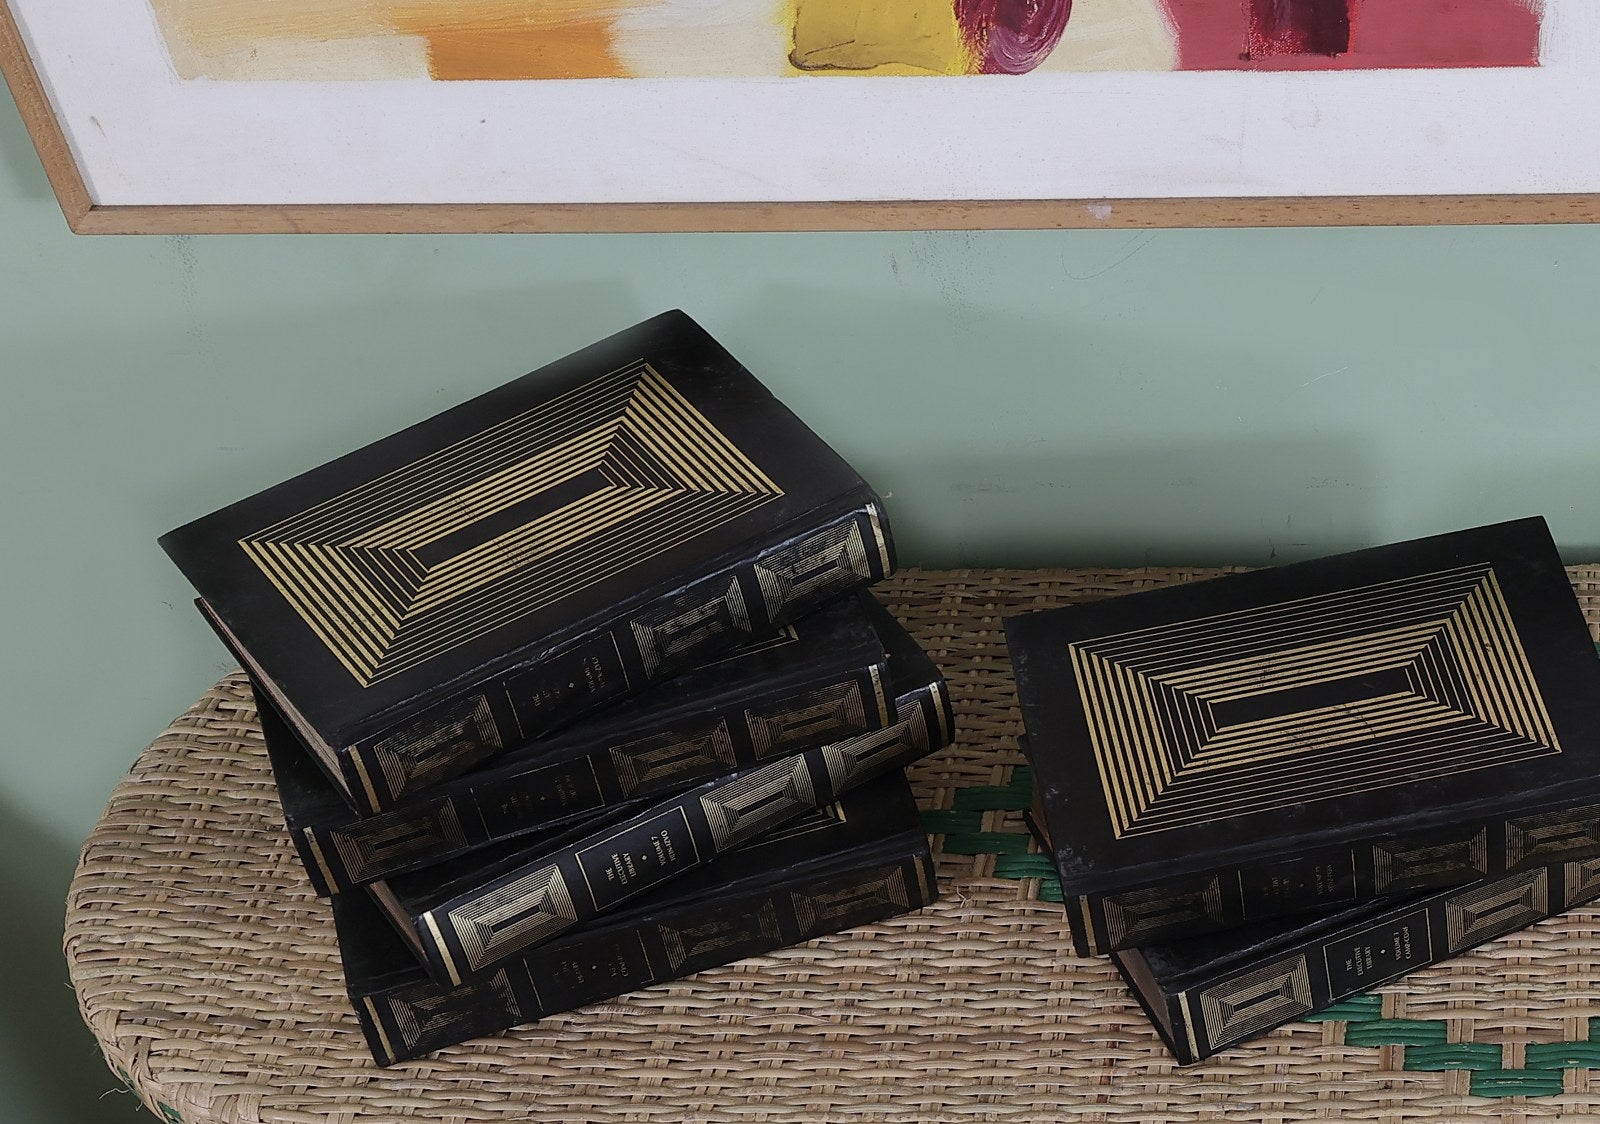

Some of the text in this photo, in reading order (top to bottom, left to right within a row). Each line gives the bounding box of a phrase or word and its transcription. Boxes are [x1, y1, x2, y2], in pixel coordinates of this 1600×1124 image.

[622, 852, 636, 877] LIBRARY
[652, 839, 667, 865] VOLUME
[605, 867, 614, 880] THE
[611, 852, 628, 884] EXECUTIVE
[1353, 946, 1363, 975] EXECUTIVE
[1364, 946, 1373, 969] LIBRARY
[1393, 937, 1402, 960] VOLUME
